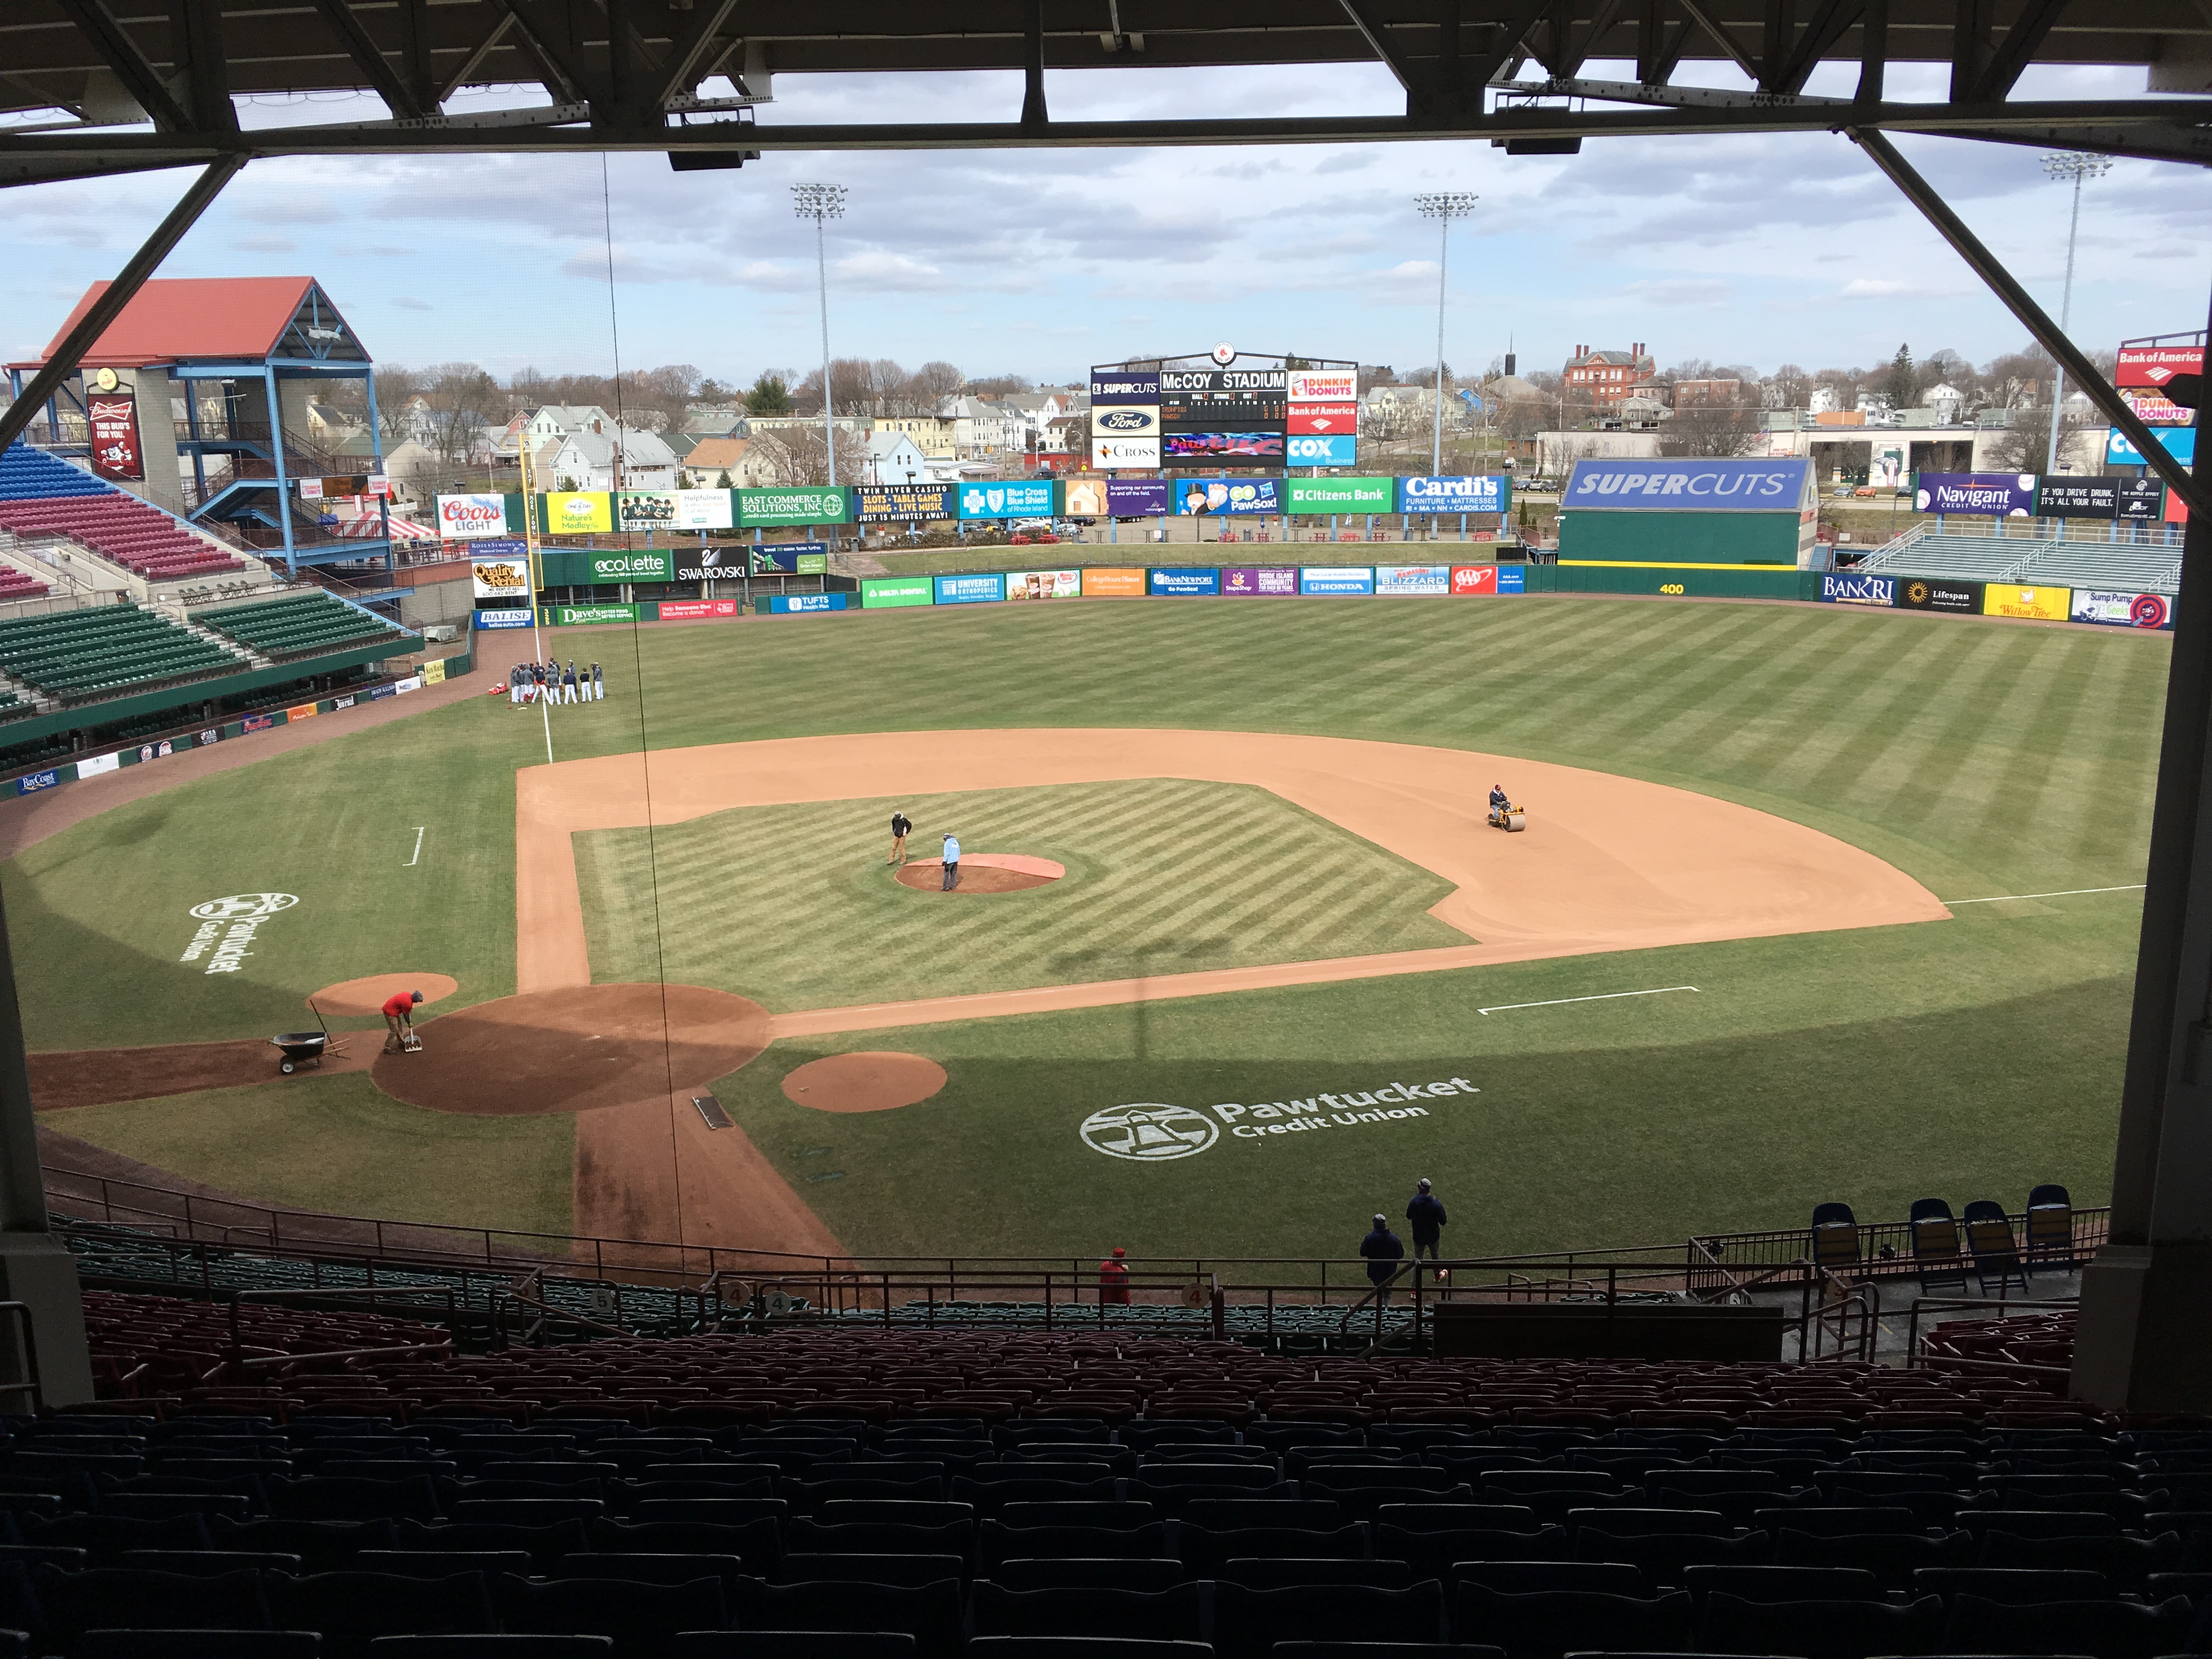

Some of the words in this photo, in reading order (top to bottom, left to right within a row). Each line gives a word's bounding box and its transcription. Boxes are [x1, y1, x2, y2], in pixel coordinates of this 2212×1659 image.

[2119, 352, 2146, 363] Bank
[2146, 352, 2158, 363] of
[2158, 351, 2202, 362] America
[1163, 373, 1212, 388] McCOY
[1223, 373, 1285, 388] STADIUM
[1308, 377, 1354, 386] DUNKIN'
[1103, 383, 1157, 394] SUPERCUTS
[1308, 387, 1351, 396] DONUTS
[89, 407, 132, 416] Budweiser
[1288, 407, 1310, 415] Bank
[1311, 406, 1319, 415] of
[1320, 406, 1355, 415] America
[2138, 409, 2187, 420] DONUTS
[1109, 413, 1143, 427] Ford
[1114, 445, 1155, 457] CROSS
[1288, 438, 1334, 459] COX
[1406, 476, 1498, 496] Cardi's
[1576, 473, 1787, 495] SUPERCUTS
[1007, 488, 1024, 496] Blue
[1025, 488, 1048, 496] Cross
[1229, 485, 1256, 501] GO
[1305, 489, 1352, 501] Citizens
[1355, 489, 1384, 500] Bank
[1937, 486, 2011, 506] Navigant
[2041, 488, 2049, 496] IF
[2067, 488, 2087, 496] DRIVE
[2090, 489, 2114, 498] DRUNK,
[742, 496, 765, 504] EAST
[768, 495, 822, 504] COMMERCE
[863, 495, 887, 504] SLOTS
[893, 494, 916, 504] TABLE
[917, 493, 943, 502] GAMES
[1007, 496, 1024, 505] Blue
[1025, 496, 1048, 504] Shield
[1231, 497, 1277, 511] PawSox!
[2041, 497, 2054, 505] IT'S
[2073, 498, 2089, 506] YOUR
[2092, 499, 2113, 507] FAULT.
[442, 500, 501, 521] Coors
[742, 504, 802, 513] SOLUTIONS,
[864, 504, 892, 513] DINING
[899, 503, 917, 512] LIVE
[919, 503, 943, 511] MUSIC
[891, 512, 923, 521] MINUTES
[455, 521, 492, 531] LIGHT
[562, 521, 590, 530] Medley
[605, 555, 664, 572] collette
[473, 564, 515, 585] Quality
[679, 566, 745, 580] SWAROVSKI
[490, 574, 526, 588] Rental
[957, 578, 998, 588] UNIVERSITY
[1086, 575, 1140, 584] CollegeBoundSaver
[1381, 577, 1445, 585] BLIZZARD
[1660, 584, 1684, 594] 400
[1824, 577, 1894, 600] BANKRI
[802, 596, 829, 604] TUFTS
[1933, 590, 1970, 600] Lifespan
[2091, 592, 2111, 603] Sump
[2112, 593, 2133, 605] Pump
[483, 611, 530, 620] BALISE
[563, 607, 601, 622] Dave's
[2000, 605, 2034, 616] Willow
[2029, 606, 2051, 618] Tree
[2106, 604, 2129, 616] Geeks
[335, 695, 354, 710] Journal
[22, 772, 54, 788] BayCoast
[192, 920, 225, 941] Credit
[179, 939, 215, 962] Union
[205, 915, 270, 974] Pawtucket
[1211, 1076, 1481, 1124] Pawtucket
[1232, 1114, 1331, 1138] Credit
[1331, 1103, 1430, 1126] Union
[729, 1288, 742, 1302] 4
[1189, 1291, 1201, 1304] 4
[597, 1295, 607, 1308] 5
[772, 1297, 783, 1310] 4
